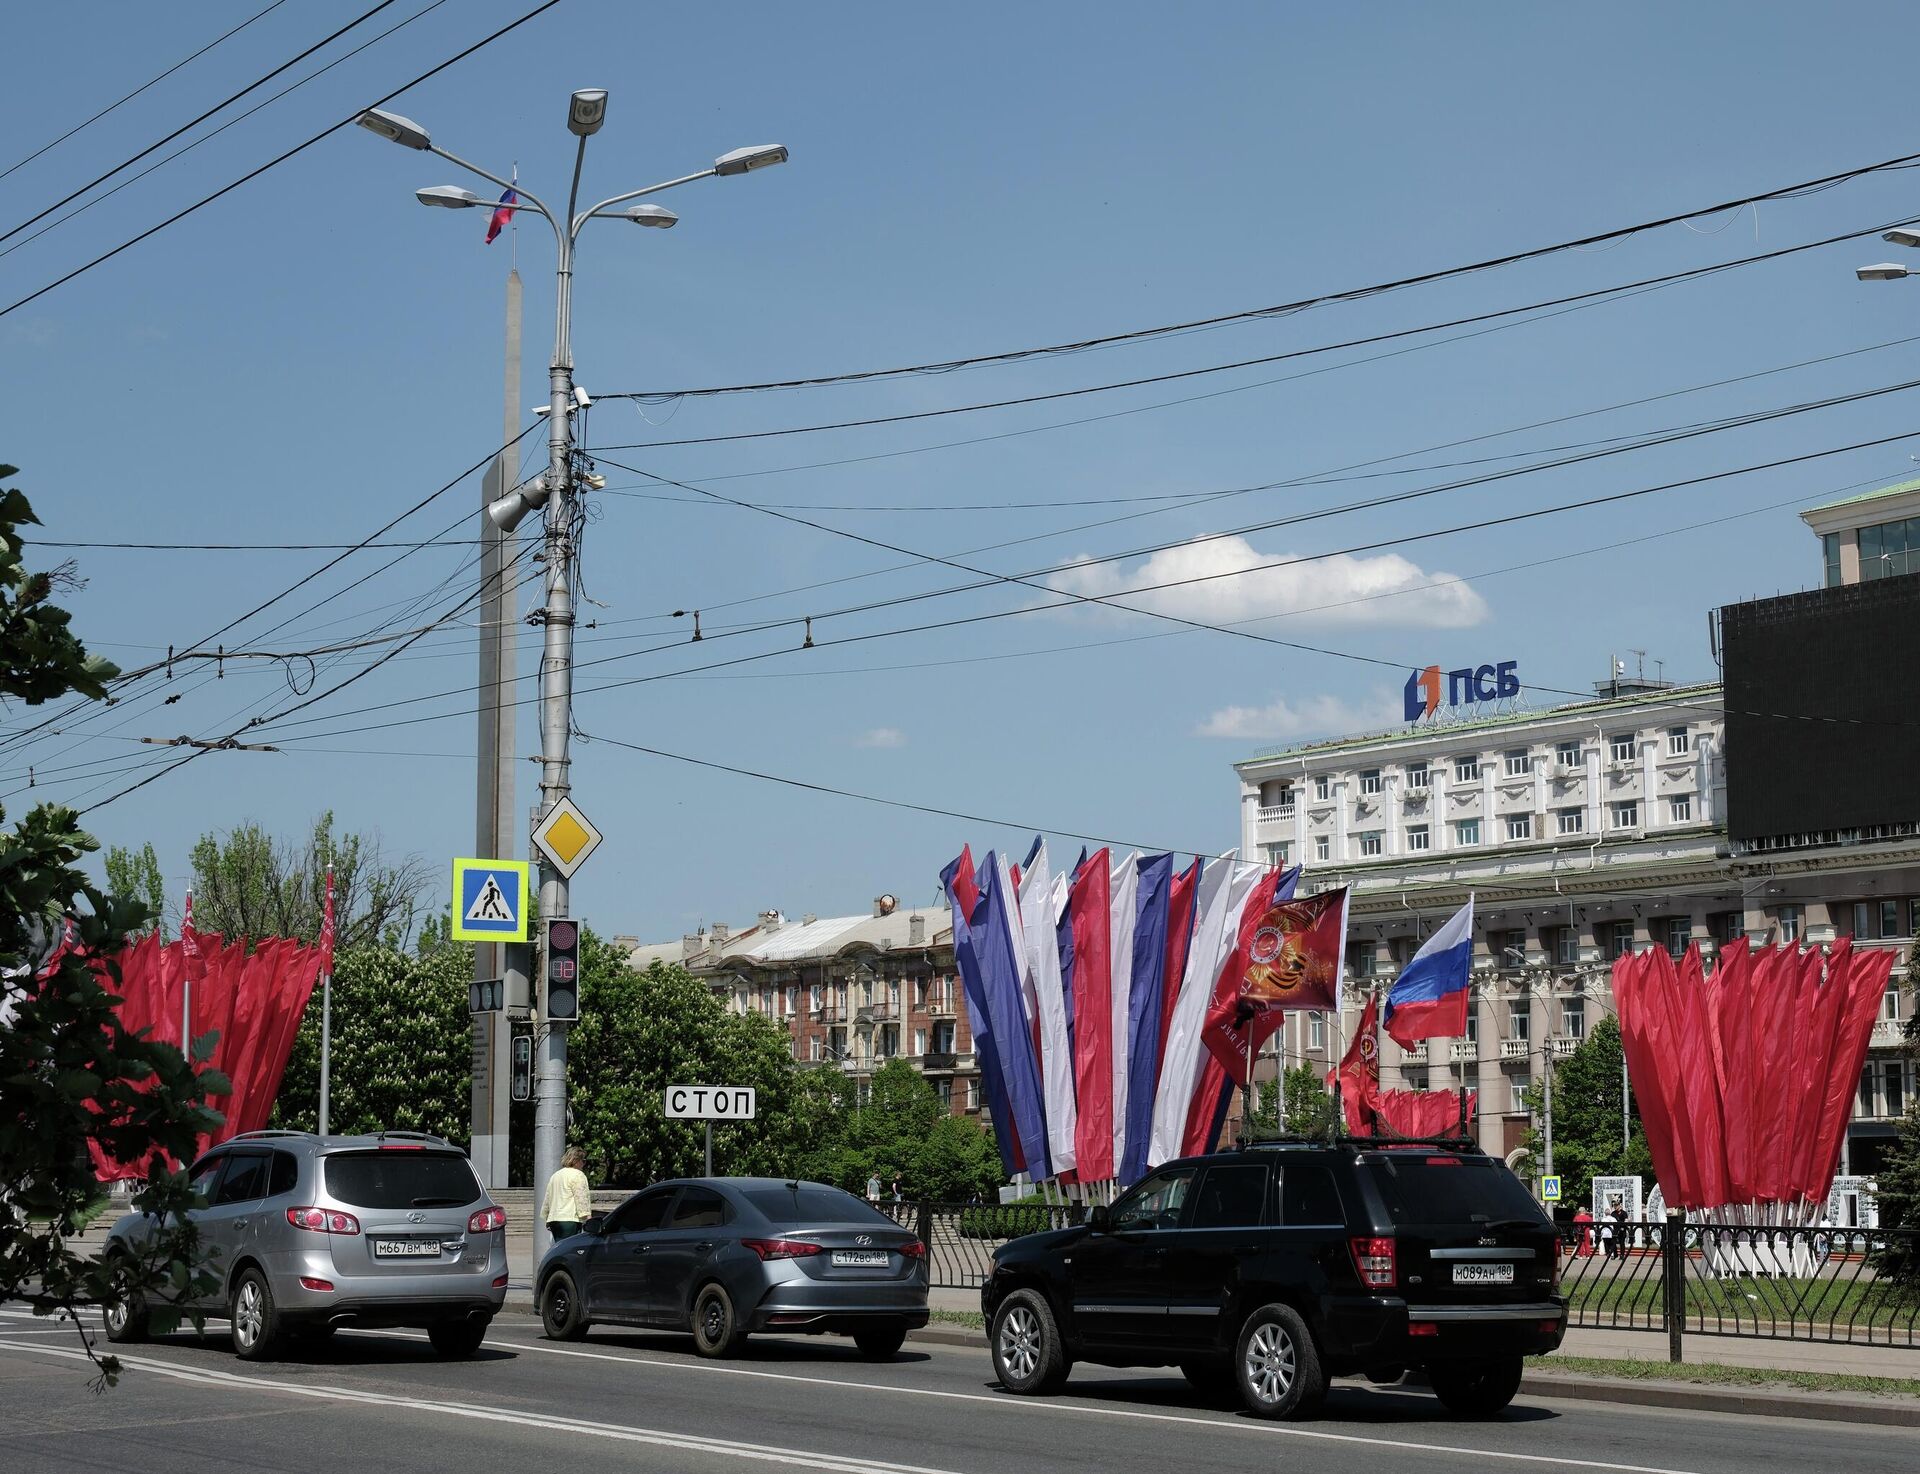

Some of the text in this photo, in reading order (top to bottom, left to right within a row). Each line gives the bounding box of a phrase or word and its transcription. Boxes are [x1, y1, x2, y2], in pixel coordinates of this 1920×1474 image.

[1449, 660, 1520, 707] ПСБ
[671, 1090, 750, 1115] СТОП
[379, 1241, 437, 1254] М667ВМ 180
[836, 1250, 887, 1263] С172ВО 180
[1455, 1265, 1512, 1280] М089АН 180
